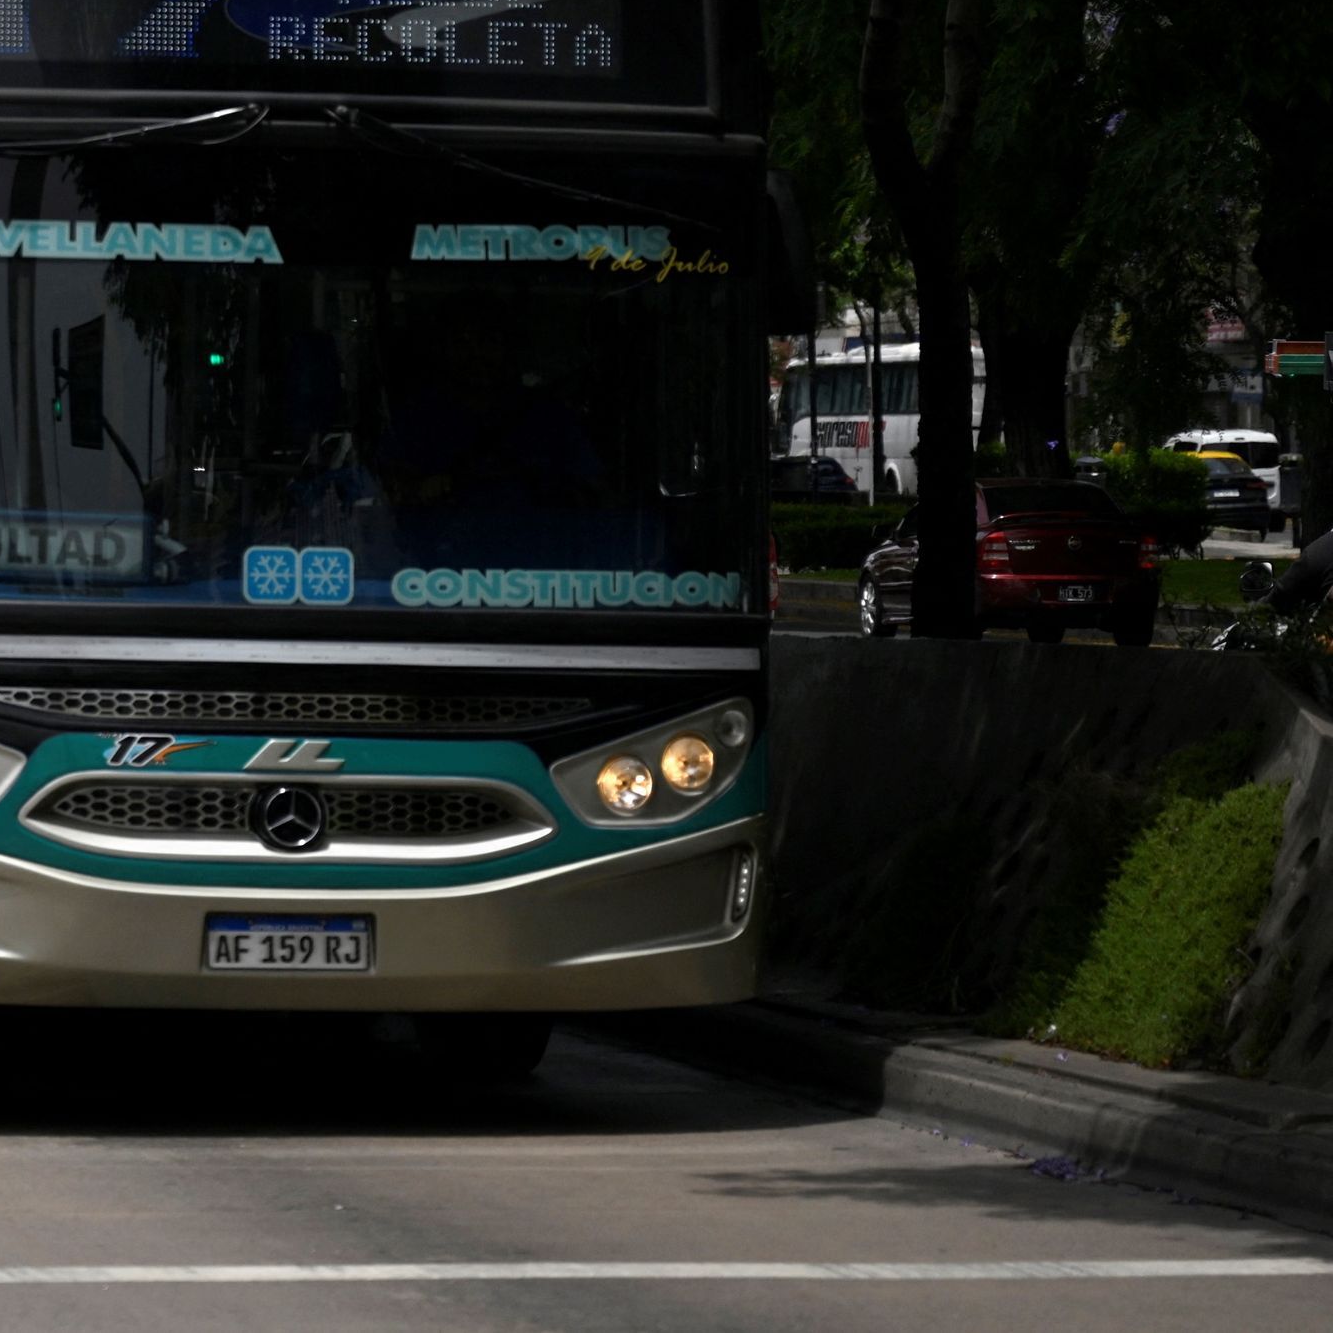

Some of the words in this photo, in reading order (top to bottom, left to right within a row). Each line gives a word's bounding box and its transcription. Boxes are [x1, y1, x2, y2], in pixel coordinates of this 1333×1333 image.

[268, 15, 613, 67] RECOLETA
[411, 223, 675, 262] METROBUS
[609, 250, 646, 274] de
[653, 245, 731, 283] Julio
[391, 567, 741, 608] CONSTITUCION
[106, 732, 176, 768] 17
[215, 935, 250, 964] AF
[261, 935, 314, 964] 159
[326, 935, 361, 964] RJ
